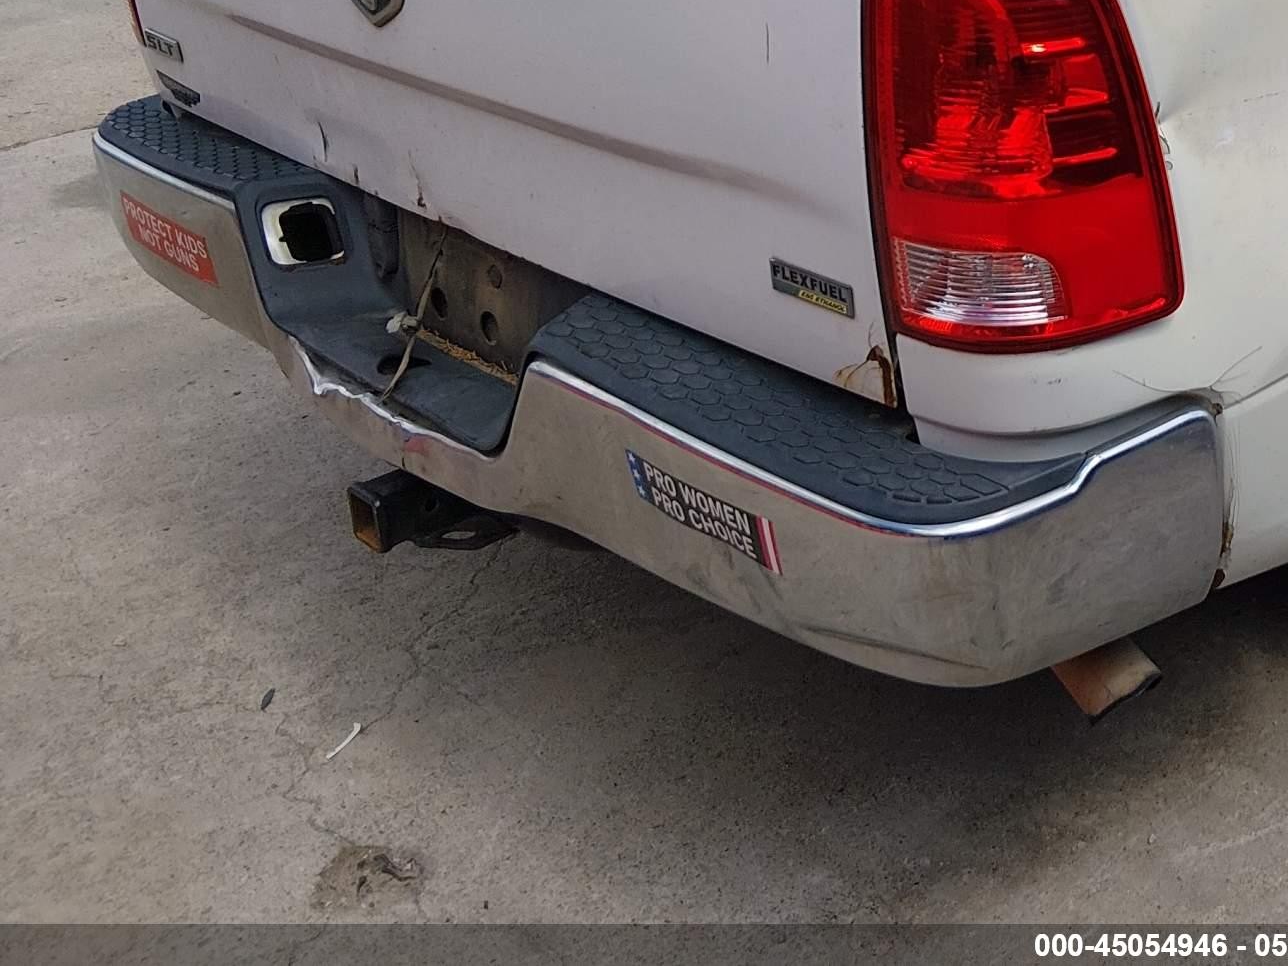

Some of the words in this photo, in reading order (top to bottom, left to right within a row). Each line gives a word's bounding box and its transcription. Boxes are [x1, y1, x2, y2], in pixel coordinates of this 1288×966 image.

[146, 34, 174, 56] SLT
[122, 197, 172, 242] PROTECT
[174, 228, 208, 259] KIDS
[138, 224, 162, 251] NOT
[163, 240, 200, 272] GUNS
[772, 264, 847, 303] FLEXFUEL
[642, 462, 677, 498] PRO
[678, 481, 751, 535] WOMEN
[651, 487, 685, 522] PRO
[688, 508, 758, 559] CHOICE
